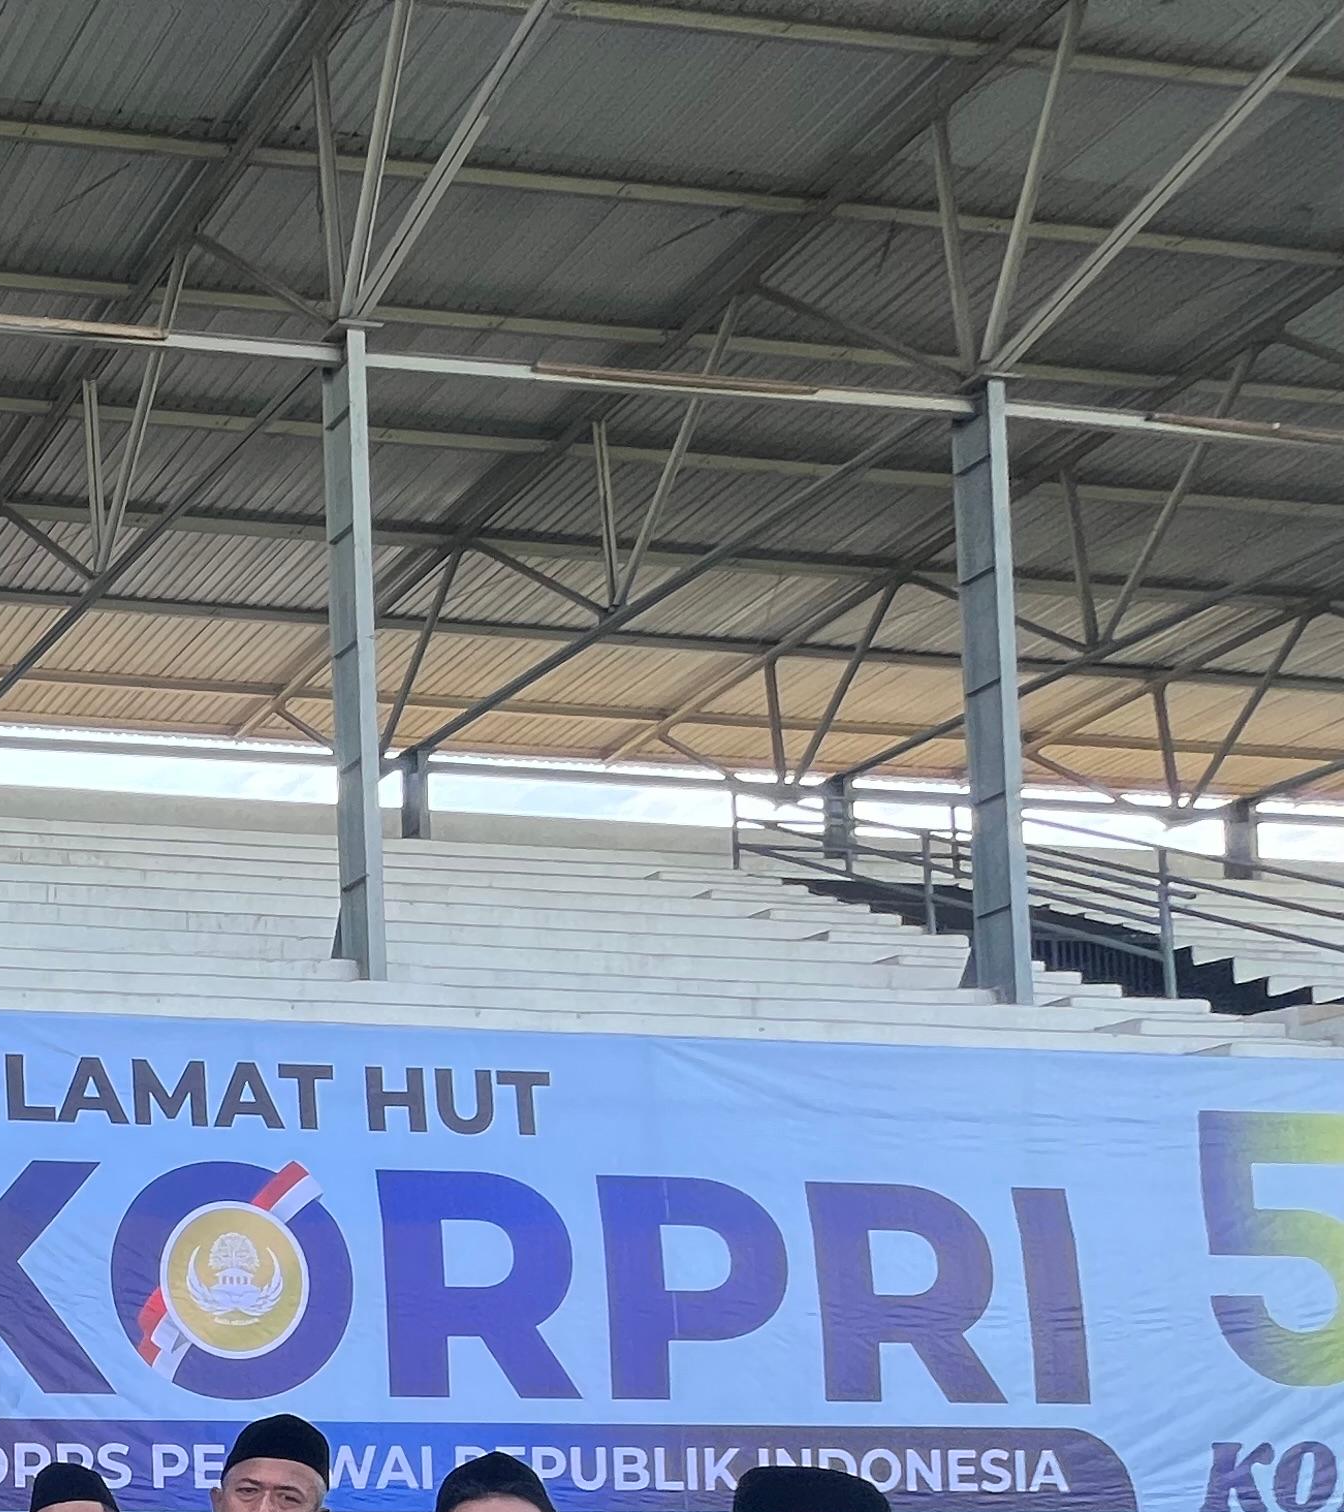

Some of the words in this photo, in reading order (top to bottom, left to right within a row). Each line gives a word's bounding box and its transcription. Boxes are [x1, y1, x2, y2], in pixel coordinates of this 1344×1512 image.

[364, 1065, 551, 1136] HUT
[151, 1444, 433, 1490] PEWAI
[454, 1445, 741, 1492] PUBLIK
